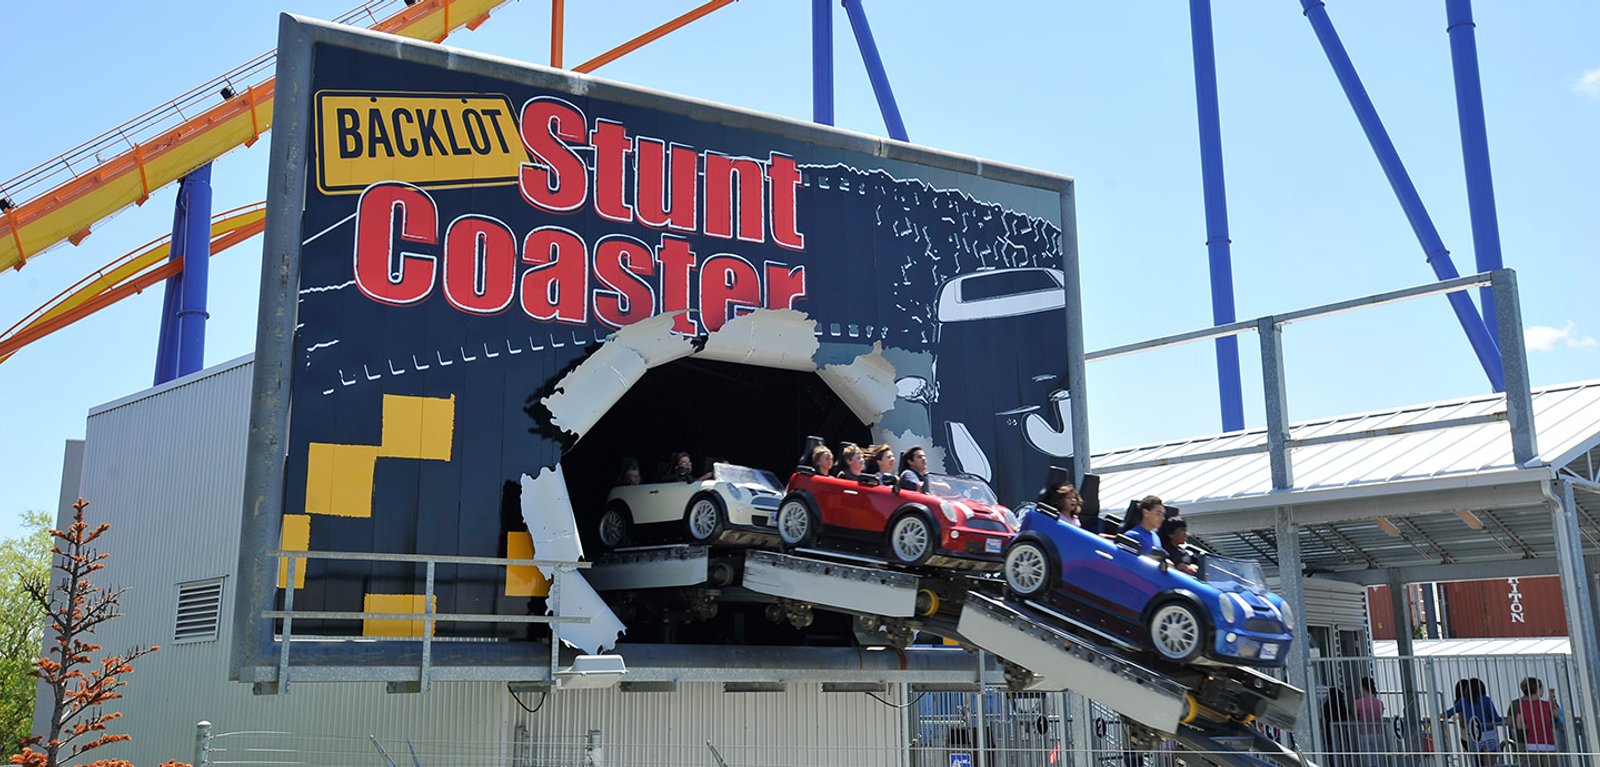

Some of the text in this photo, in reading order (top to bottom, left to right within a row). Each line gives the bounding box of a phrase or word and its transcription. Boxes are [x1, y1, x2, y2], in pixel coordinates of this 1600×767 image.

[337, 107, 510, 160] BACKLOT
[518, 95, 807, 252] Stunt
[354, 180, 806, 337] Coaster
